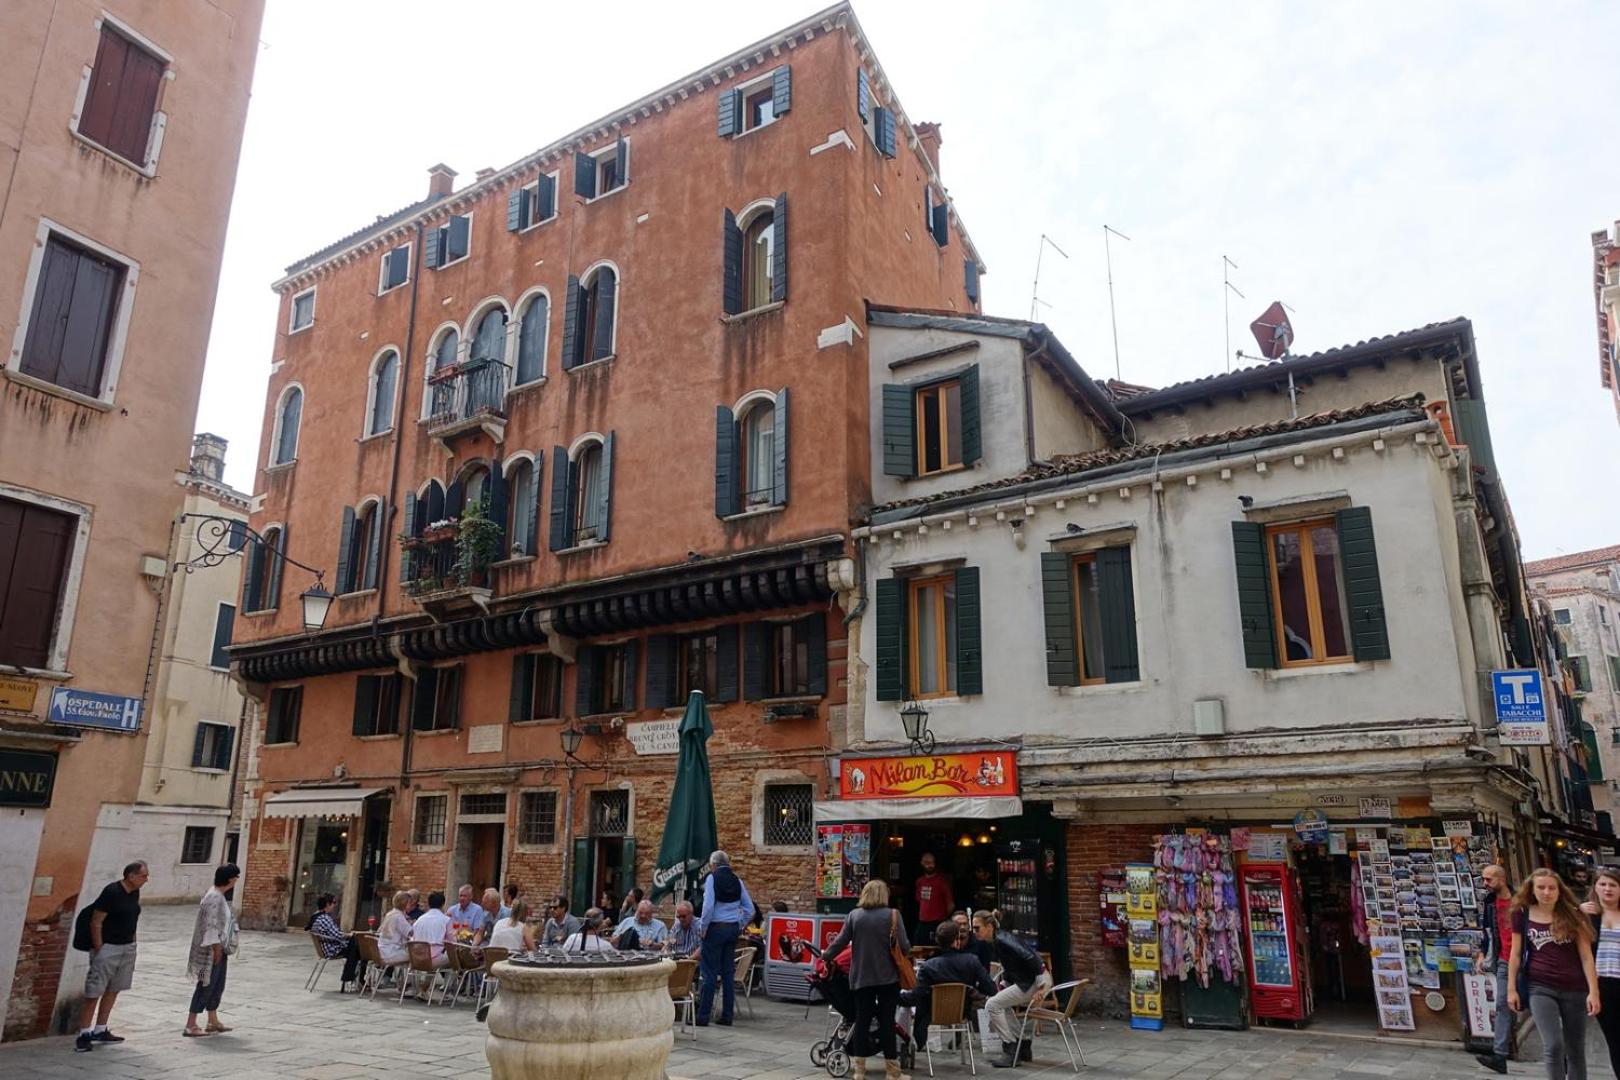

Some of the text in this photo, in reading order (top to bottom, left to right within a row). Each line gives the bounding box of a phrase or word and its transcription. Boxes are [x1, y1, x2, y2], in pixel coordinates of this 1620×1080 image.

[1500, 675, 1533, 704] T
[67, 698, 140, 728] OSPEDALE H
[869, 757, 978, 793] Milan Bar
[1471, 980, 1484, 1031] DRINKS
